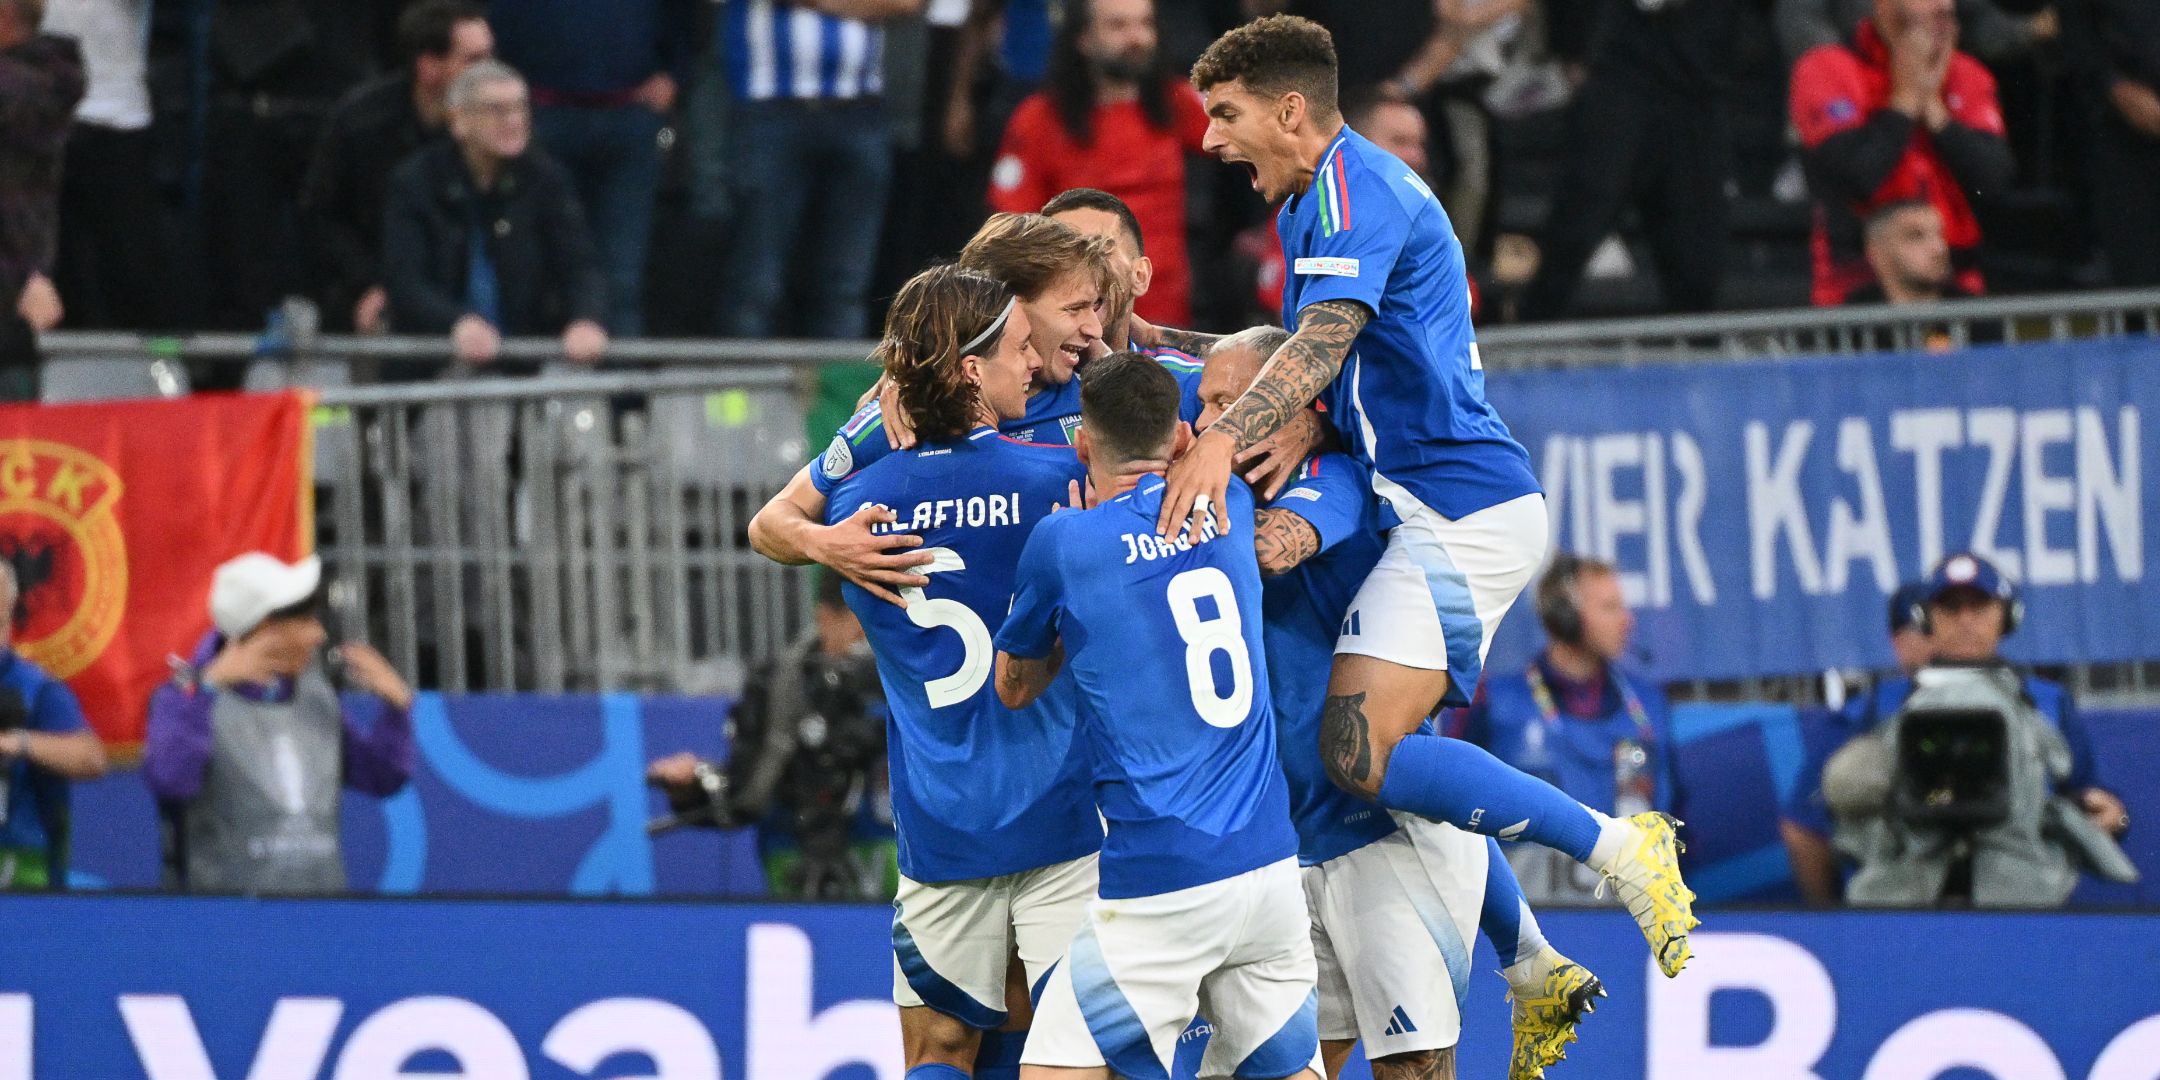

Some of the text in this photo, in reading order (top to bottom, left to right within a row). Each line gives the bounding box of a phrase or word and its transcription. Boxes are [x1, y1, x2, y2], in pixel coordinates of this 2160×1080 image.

[1120, 502, 1231, 565] JORGH
[1744, 406, 2144, 600] KATZEN
[900, 547, 993, 709] 5
[1167, 566, 1253, 728] 8
